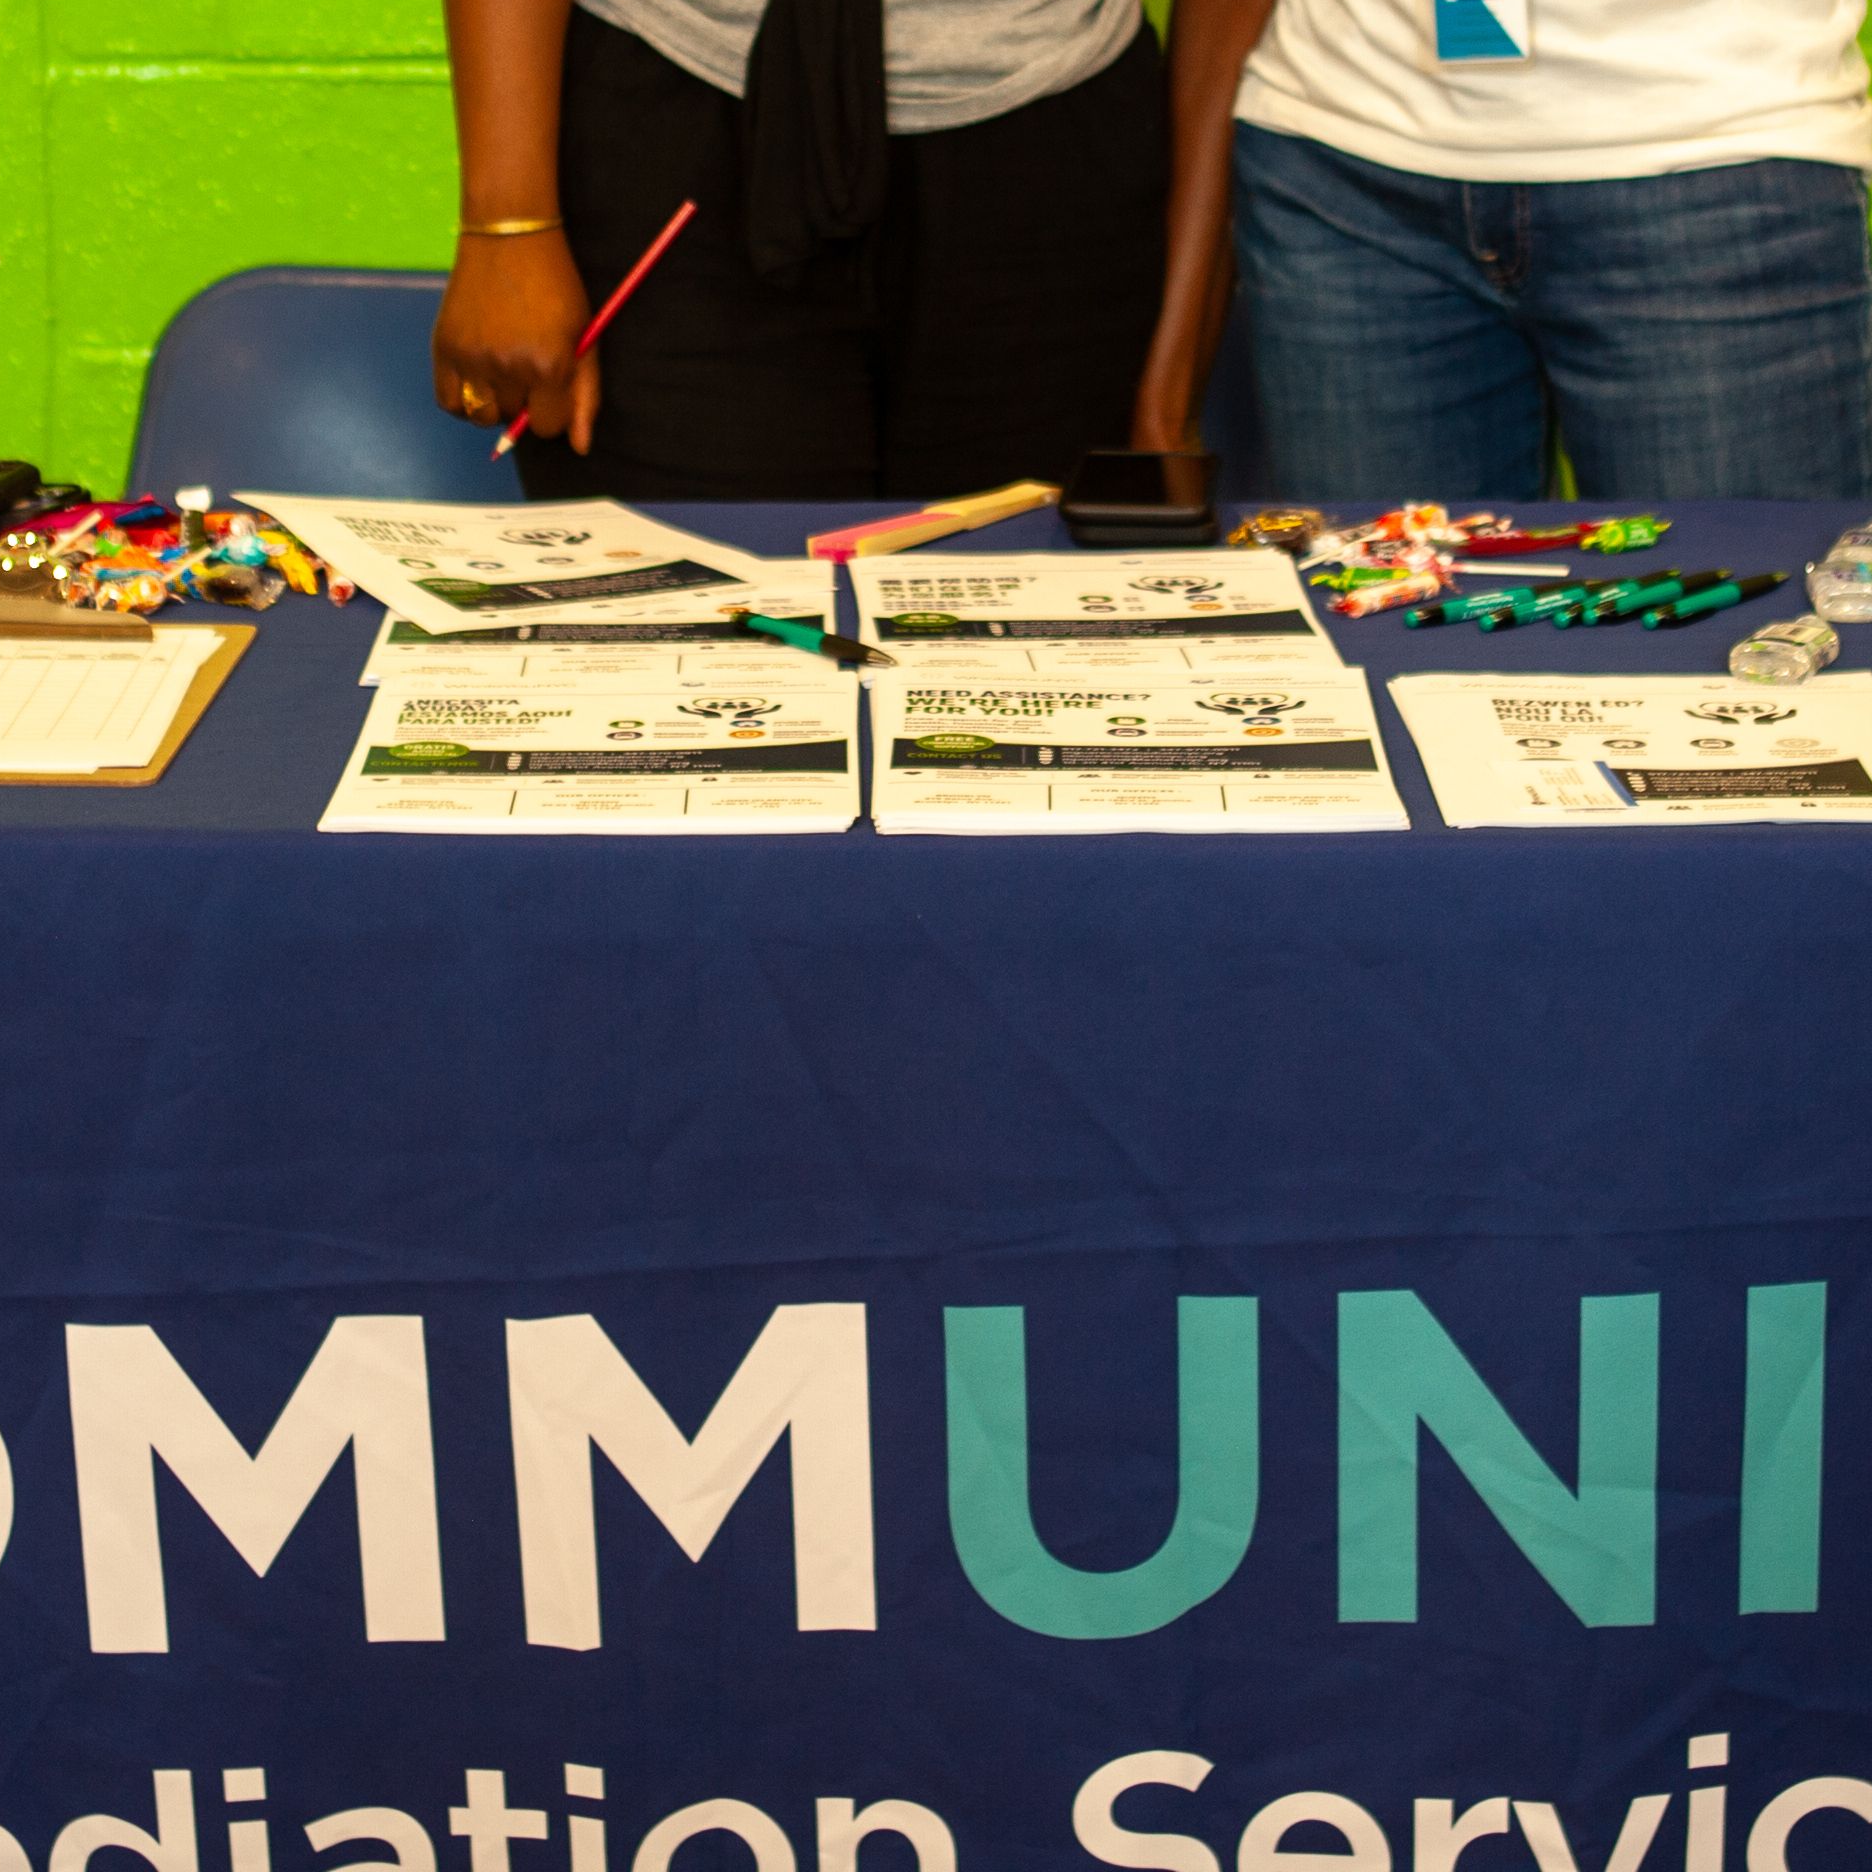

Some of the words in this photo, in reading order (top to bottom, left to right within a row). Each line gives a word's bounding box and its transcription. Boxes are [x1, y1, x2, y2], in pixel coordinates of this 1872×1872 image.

[906, 689, 972, 698] NEED
[982, 690, 1152, 702] ASSISTANCE?
[906, 698, 1009, 708] WE'RE
[1020, 699, 1103, 709] HERE
[1491, 698, 1592, 708] BEZWEN
[403, 704, 488, 712] AYUDA?
[905, 706, 966, 716] FOR
[980, 708, 1055, 717] YOU!
[1494, 707, 1551, 715] NOU
[1560, 707, 1595, 716] LA
[398, 717, 459, 725] PARA
[463, 717, 541, 725] USTED!
[1497, 714, 1551, 723] POU
[906, 752, 976, 760] CONTACT
